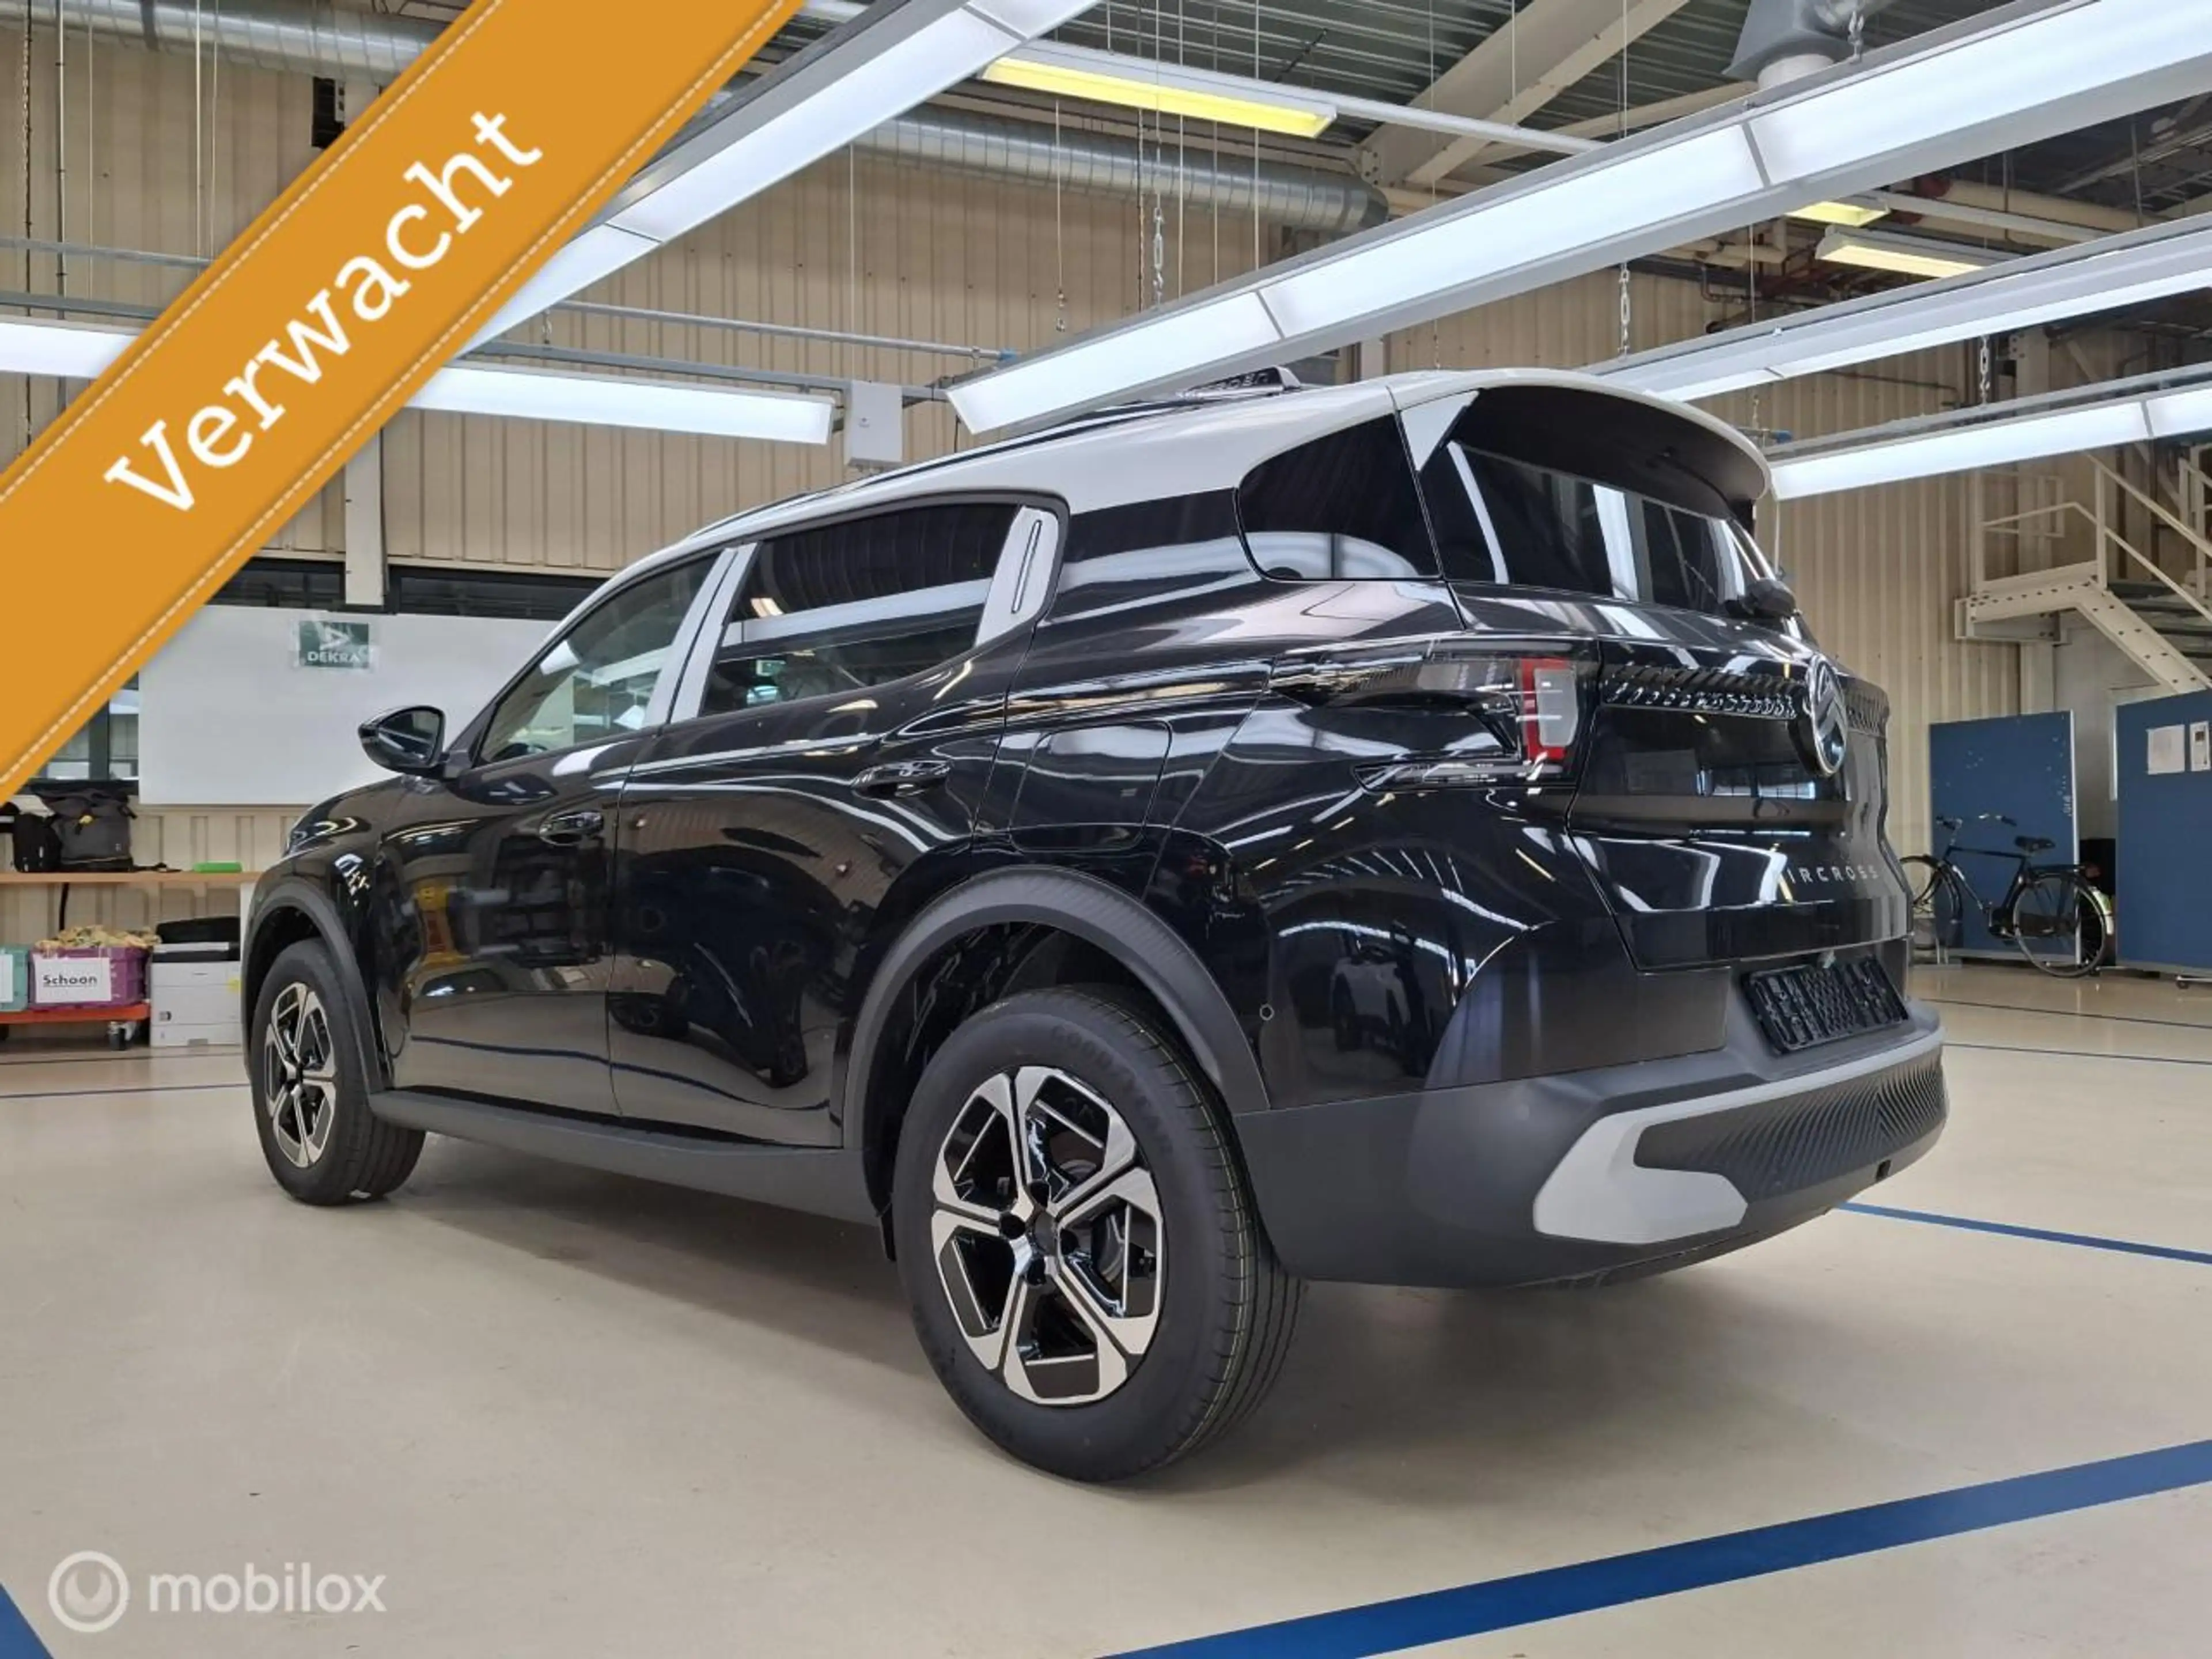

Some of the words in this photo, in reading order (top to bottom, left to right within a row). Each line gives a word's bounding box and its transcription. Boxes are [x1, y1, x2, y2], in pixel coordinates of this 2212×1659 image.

[307, 651, 361, 662] DEKRA
[1786, 865, 1878, 885] IRCROSS
[43, 974, 97, 986] Schoon
